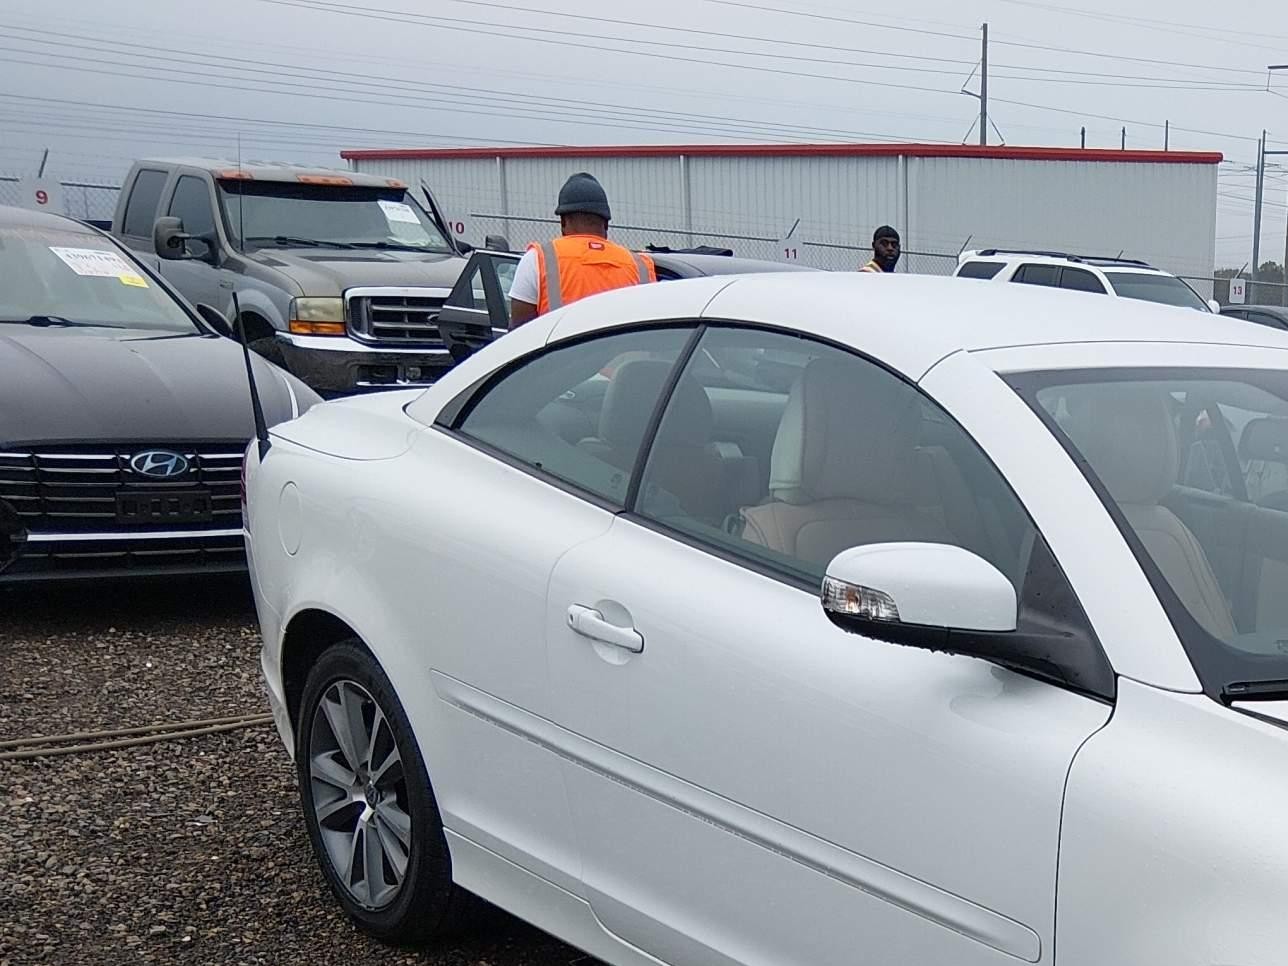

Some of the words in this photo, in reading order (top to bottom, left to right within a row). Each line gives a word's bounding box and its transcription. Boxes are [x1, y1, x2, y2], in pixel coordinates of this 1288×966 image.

[36, 190, 48, 205] 9
[784, 248, 797, 259] 11
[1233, 286, 1242, 295] 13
